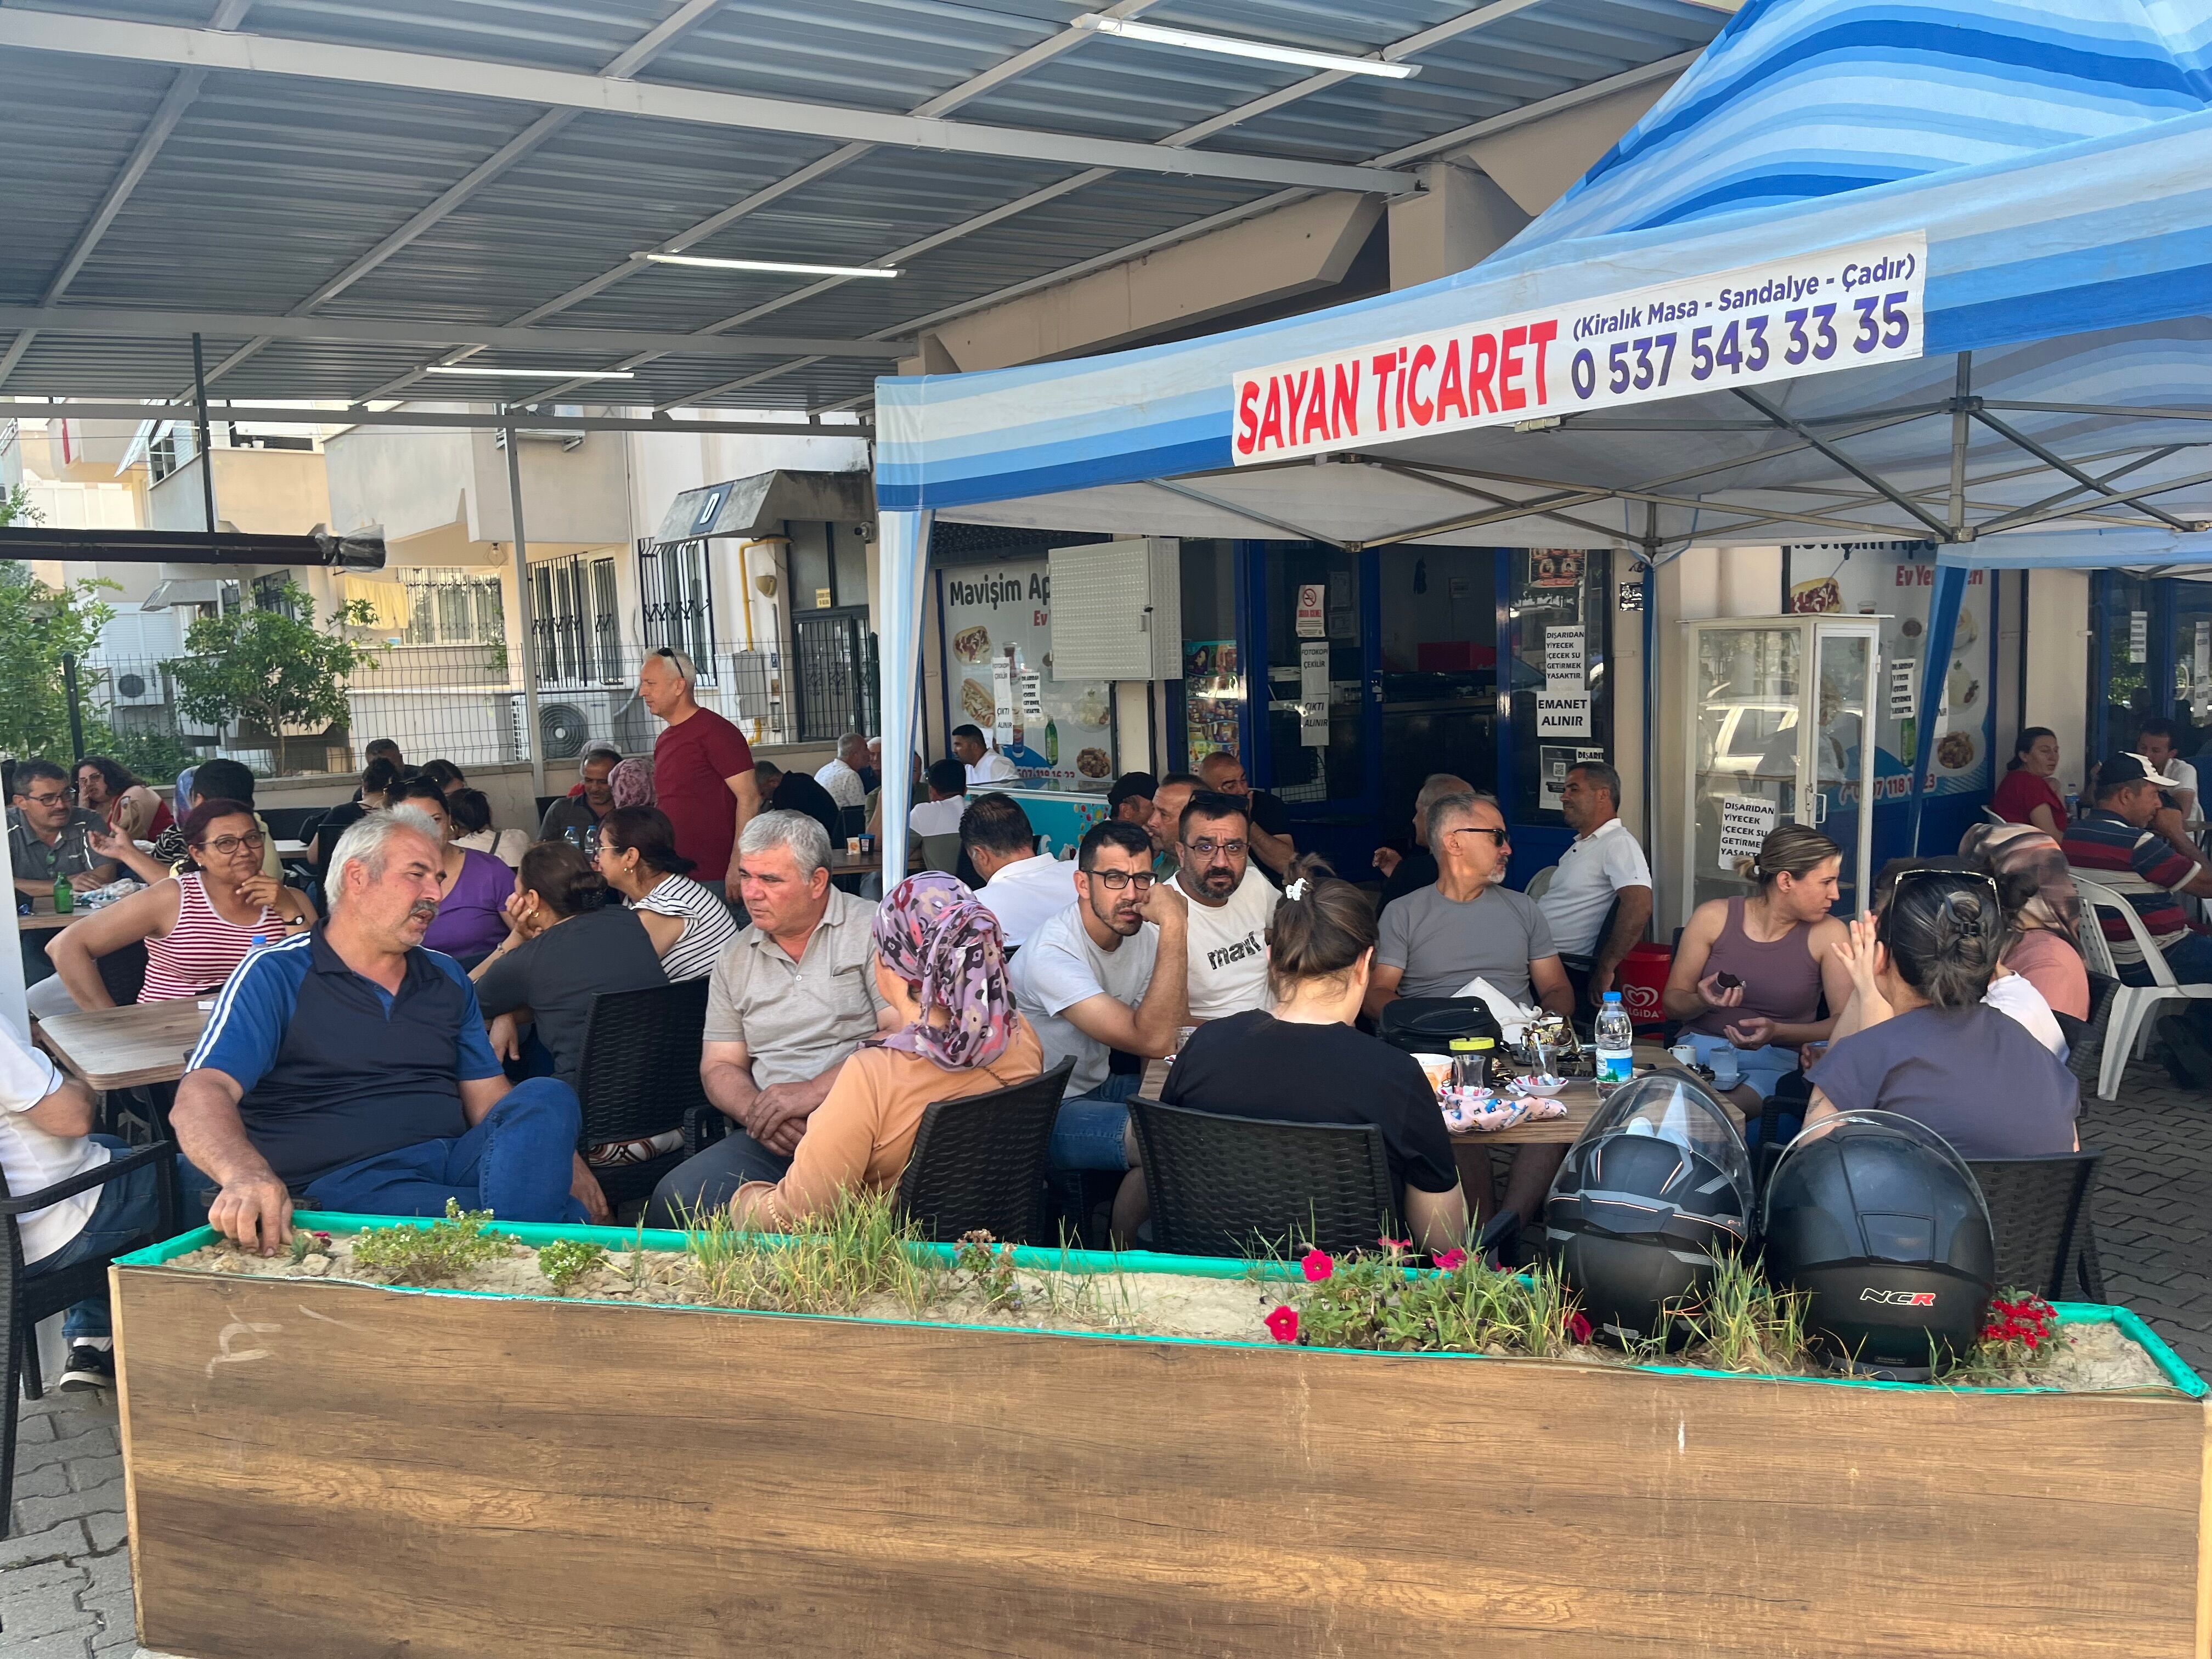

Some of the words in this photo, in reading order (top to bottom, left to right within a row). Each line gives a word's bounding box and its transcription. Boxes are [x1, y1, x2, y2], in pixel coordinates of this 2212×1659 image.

[1573, 306, 1641, 342] (Kiralık
[1647, 299, 1699, 325] Masa
[1718, 275, 1819, 311] Sandalye
[1841, 253, 1915, 292] Çadır)
[1571, 348, 1596, 400] 0
[1609, 331, 1677, 394] 537
[1690, 315, 1769, 380] 543
[1784, 303, 1837, 365] 33
[1853, 291, 1909, 353] 35
[1237, 359, 1360, 455] SAYAN
[699, 493, 720, 524] D
[1896, 565, 1913, 586] Ev
[950, 572, 1022, 610] Mavişim
[1033, 610, 1048, 627] Ev
[1538, 699, 1587, 709] EMANET
[1304, 719, 1328, 727] ALINIR
[1541, 716, 1583, 726] ALINIR
[1887, 778, 1905, 795] 118
[1725, 802, 1774, 815] DIŞARIDAN
[1724, 813, 1760, 825] YİYECEK
[1723, 824, 1754, 835] İÇECEK
[1722, 837, 1762, 848] GETİRME
[1860, 1288, 1936, 1306] NCR
